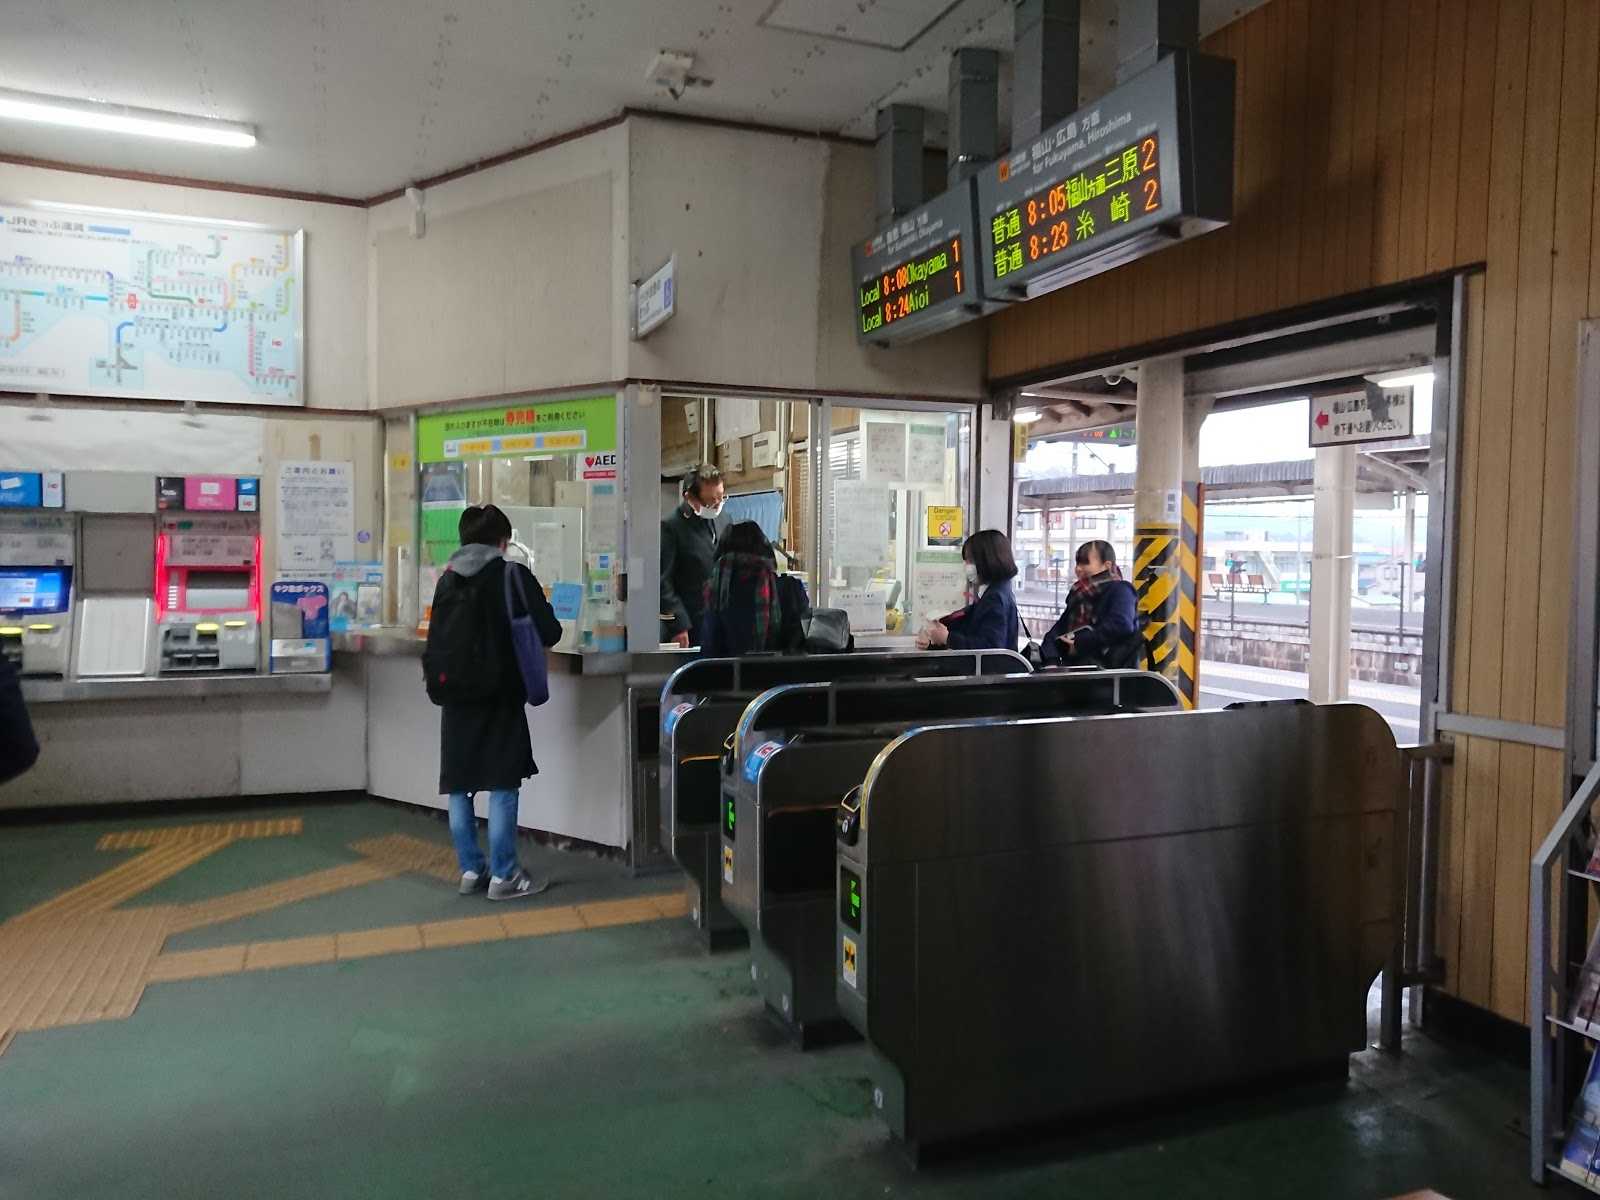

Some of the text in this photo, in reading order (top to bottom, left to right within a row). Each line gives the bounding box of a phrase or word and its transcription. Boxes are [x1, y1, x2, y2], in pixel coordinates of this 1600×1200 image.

[1087, 112, 1132, 145] Hiroshima
[992, 208, 1022, 245] 普通
[1027, 184, 1066, 226] 8:05
[1141, 138, 1156, 172] 2
[994, 242, 1024, 278] 普通
[1029, 221, 1069, 260] 8:23
[1144, 179, 1159, 212] 2
[860, 280, 880, 307] Local
[907, 252, 948, 285] Okayama
[952, 239, 959, 263] 1
[862, 270, 961, 333] Local 8:24 Aioi 1
